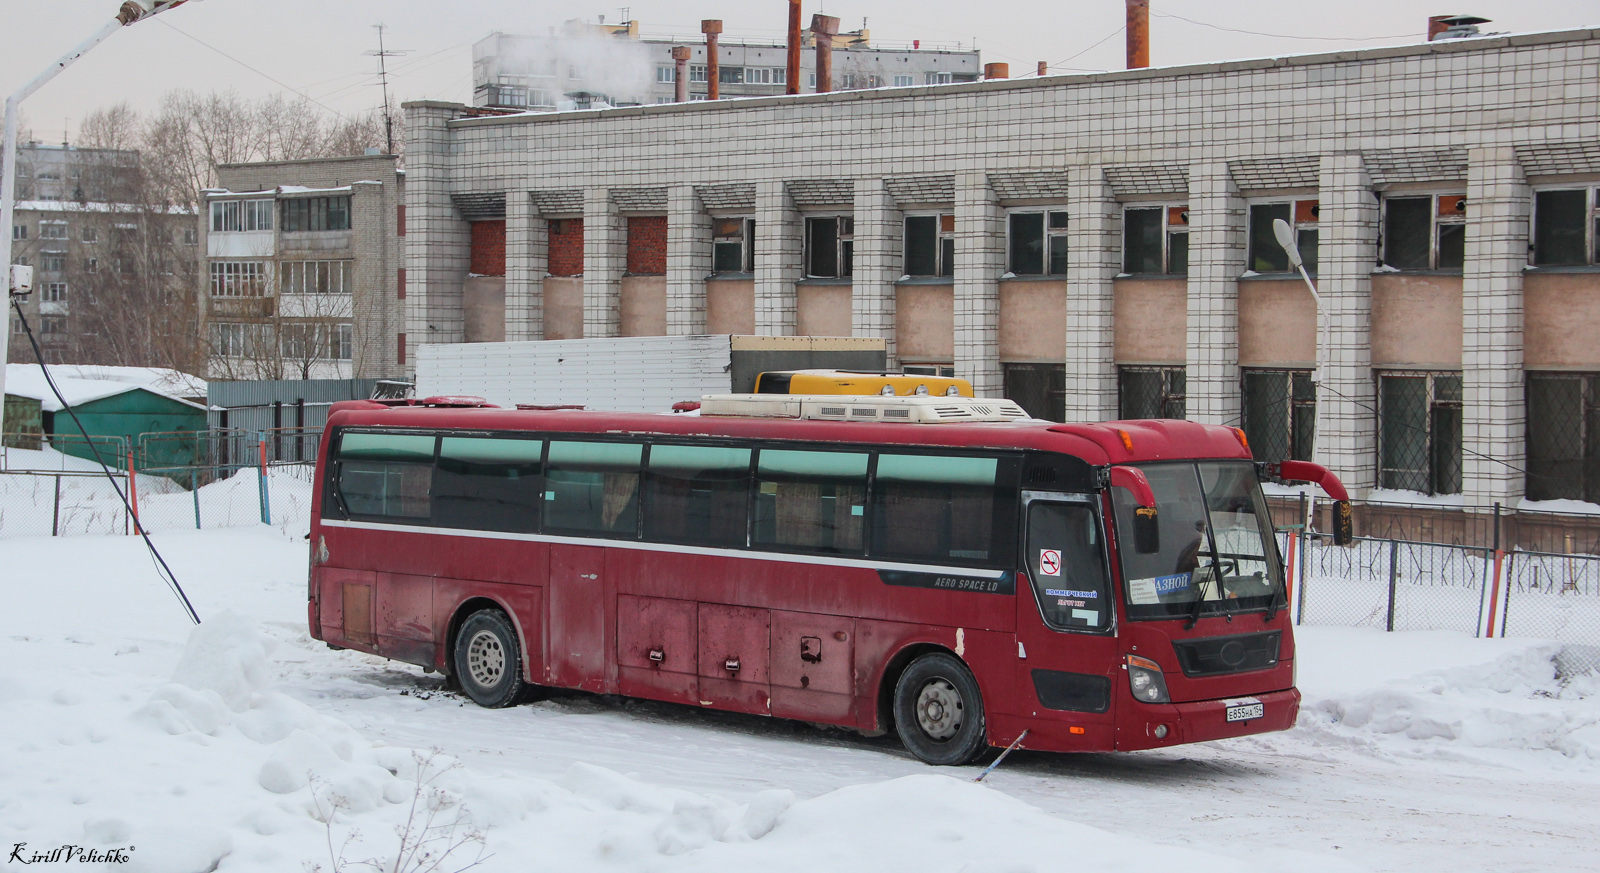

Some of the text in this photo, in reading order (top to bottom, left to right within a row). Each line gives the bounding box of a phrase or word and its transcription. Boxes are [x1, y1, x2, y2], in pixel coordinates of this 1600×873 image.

[935, 577, 998, 591] AERO SPACE LD
[1155, 573, 1188, 591] АЗНОЙ
[1045, 588, 1098, 599] КОММЕРЧЕСКИЙ
